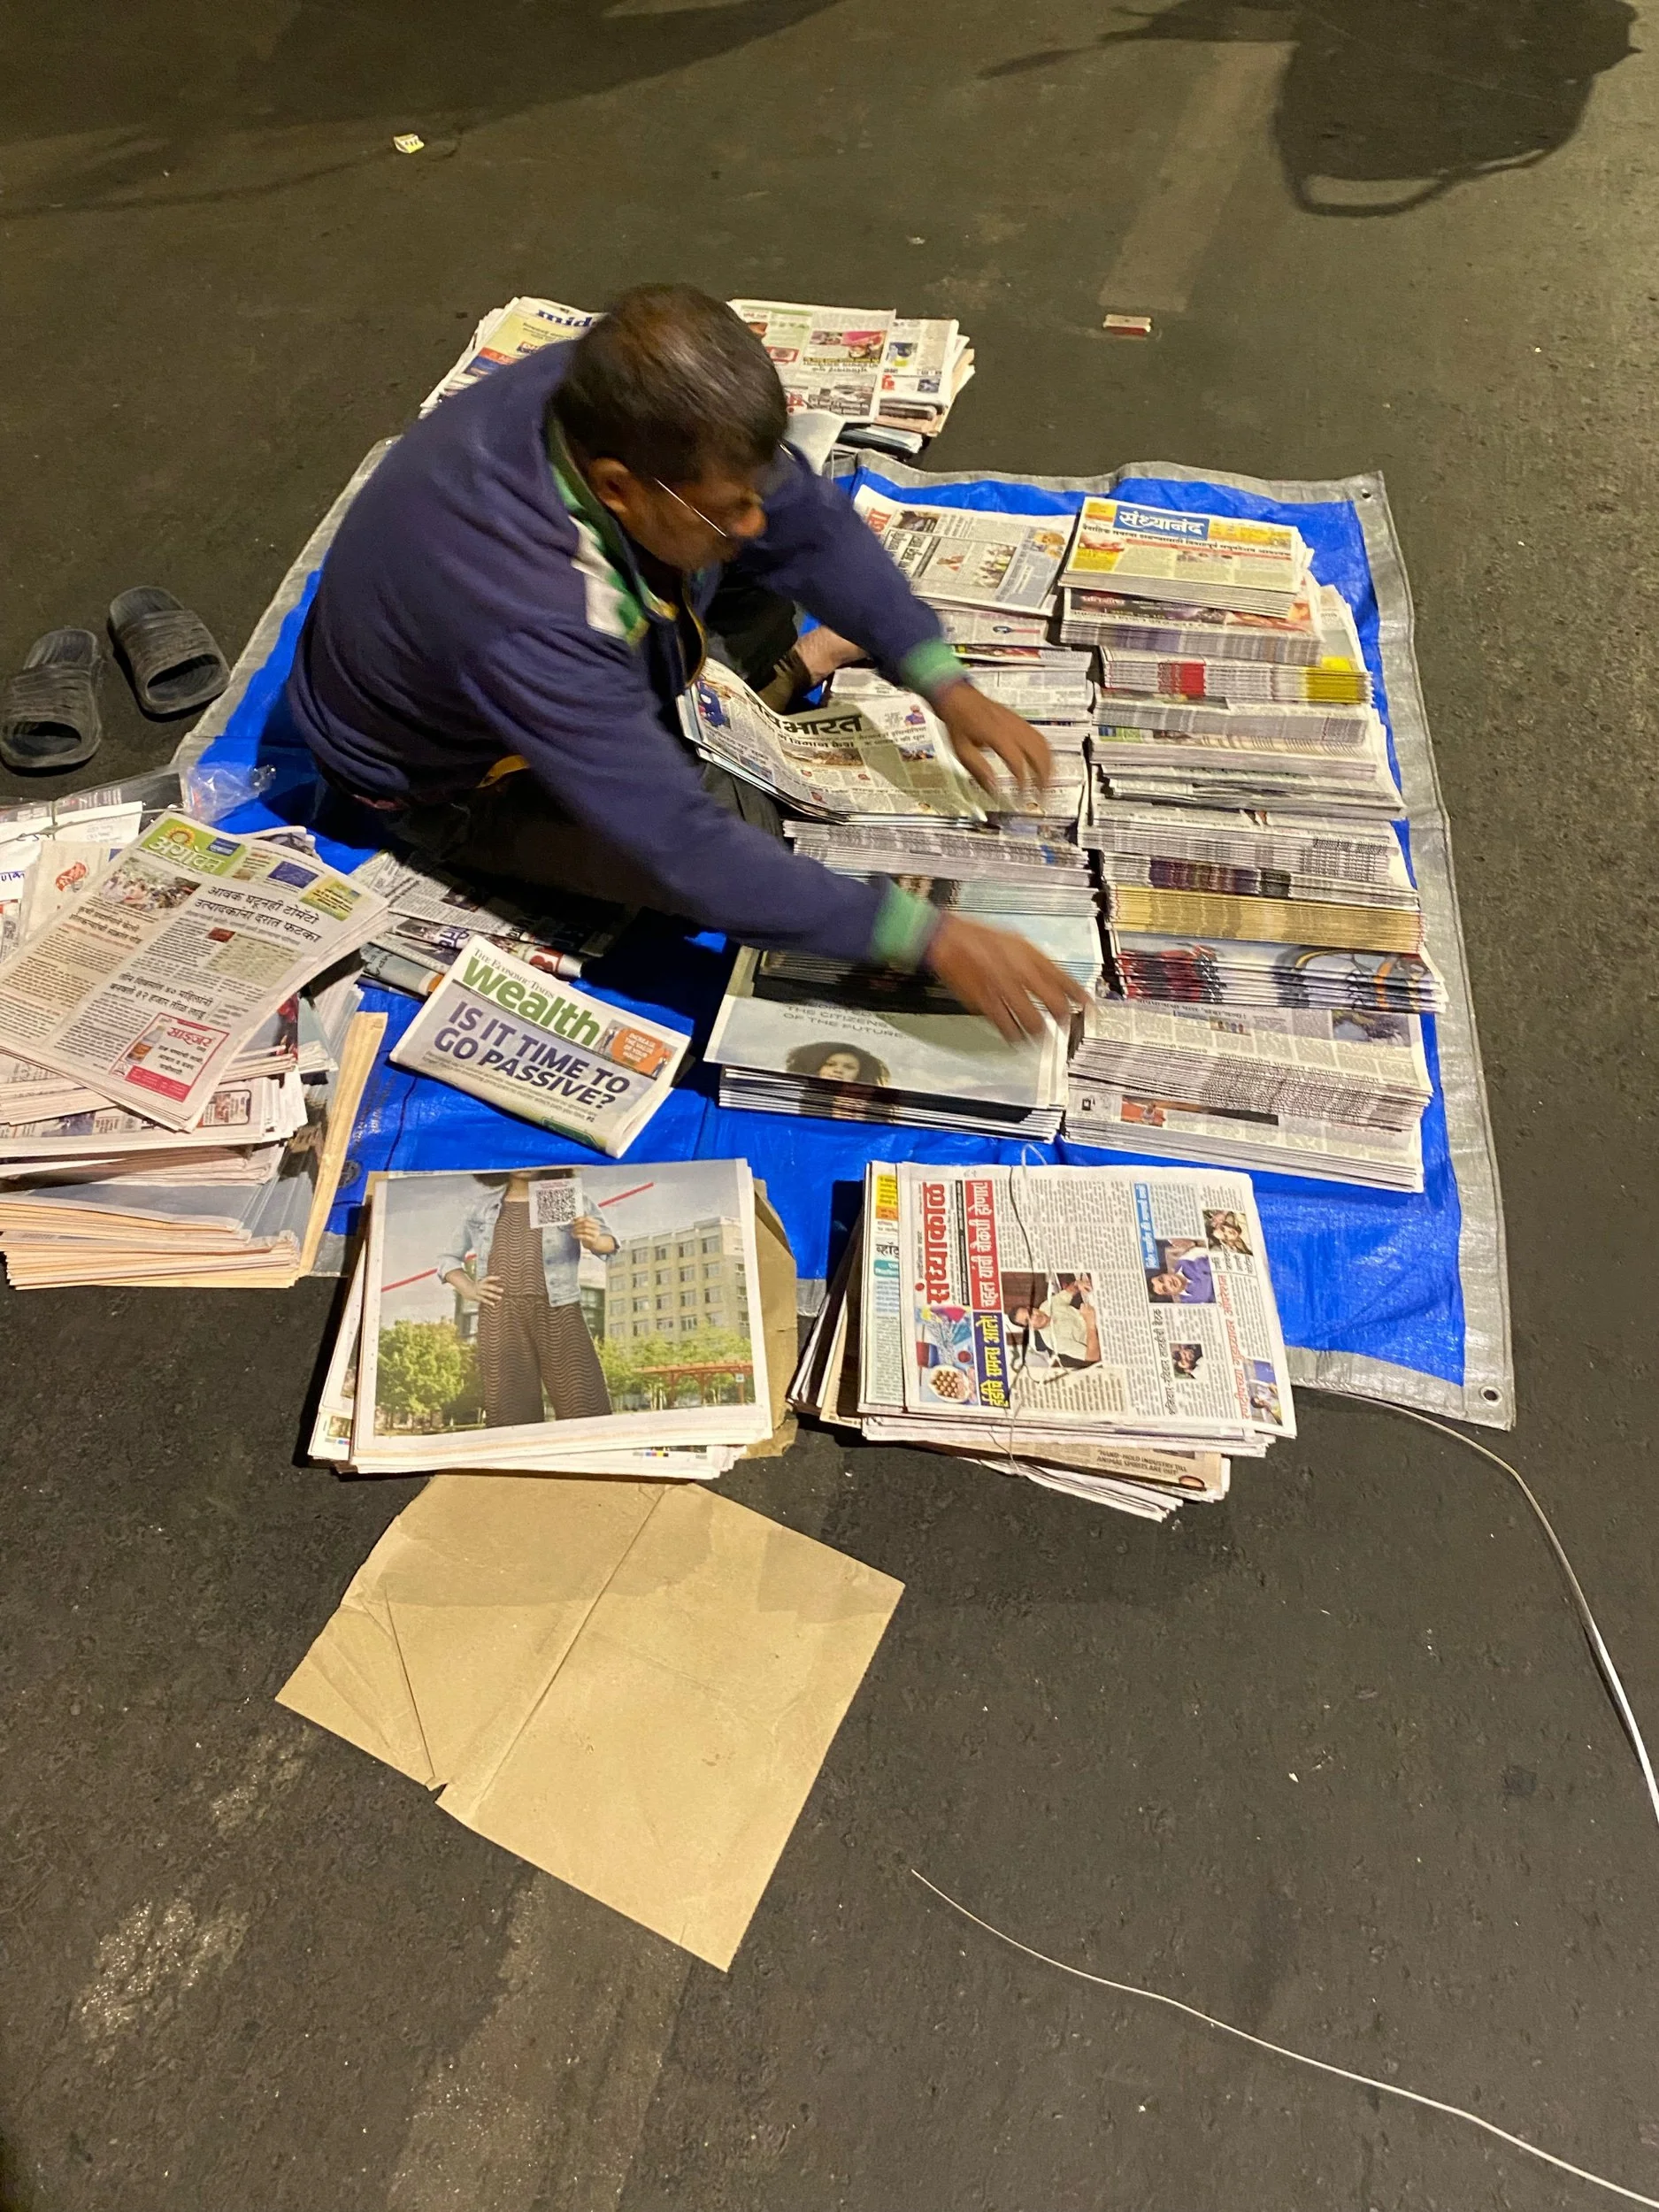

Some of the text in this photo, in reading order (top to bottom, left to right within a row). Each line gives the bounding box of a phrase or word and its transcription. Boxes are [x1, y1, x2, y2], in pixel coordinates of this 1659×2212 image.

[1118, 510, 1206, 537] संध्यानंद
[194, 898, 253, 920] उत्पादकांना
[254, 912, 282, 926] दरात
[284, 921, 322, 943] फटका
[208, 887, 320, 925] आवक घटूनही टोमॅटो
[473, 948, 491, 964] THE
[491, 957, 532, 986] ECONOMIC
[531, 981, 556, 1000] TIMES
[461, 956, 601, 1047] wealth
[807, 1018, 841, 1027] THE
[434, 1027, 479, 1060] GO
[478, 1049, 617, 1110] PASSIVE?
[449, 1002, 484, 1032] IS
[480, 1018, 516, 1047] IT
[515, 1033, 590, 1080] TIME
[588, 1067, 631, 1094] TO
[914, 1181, 950, 1306] संध्याकाळ
[967, 1182, 1000, 1309] चहल यांची चौकशी होणार!
[975, 1315, 1001, 1343] आले!
[985, 1346, 1002, 1377] समन्स
